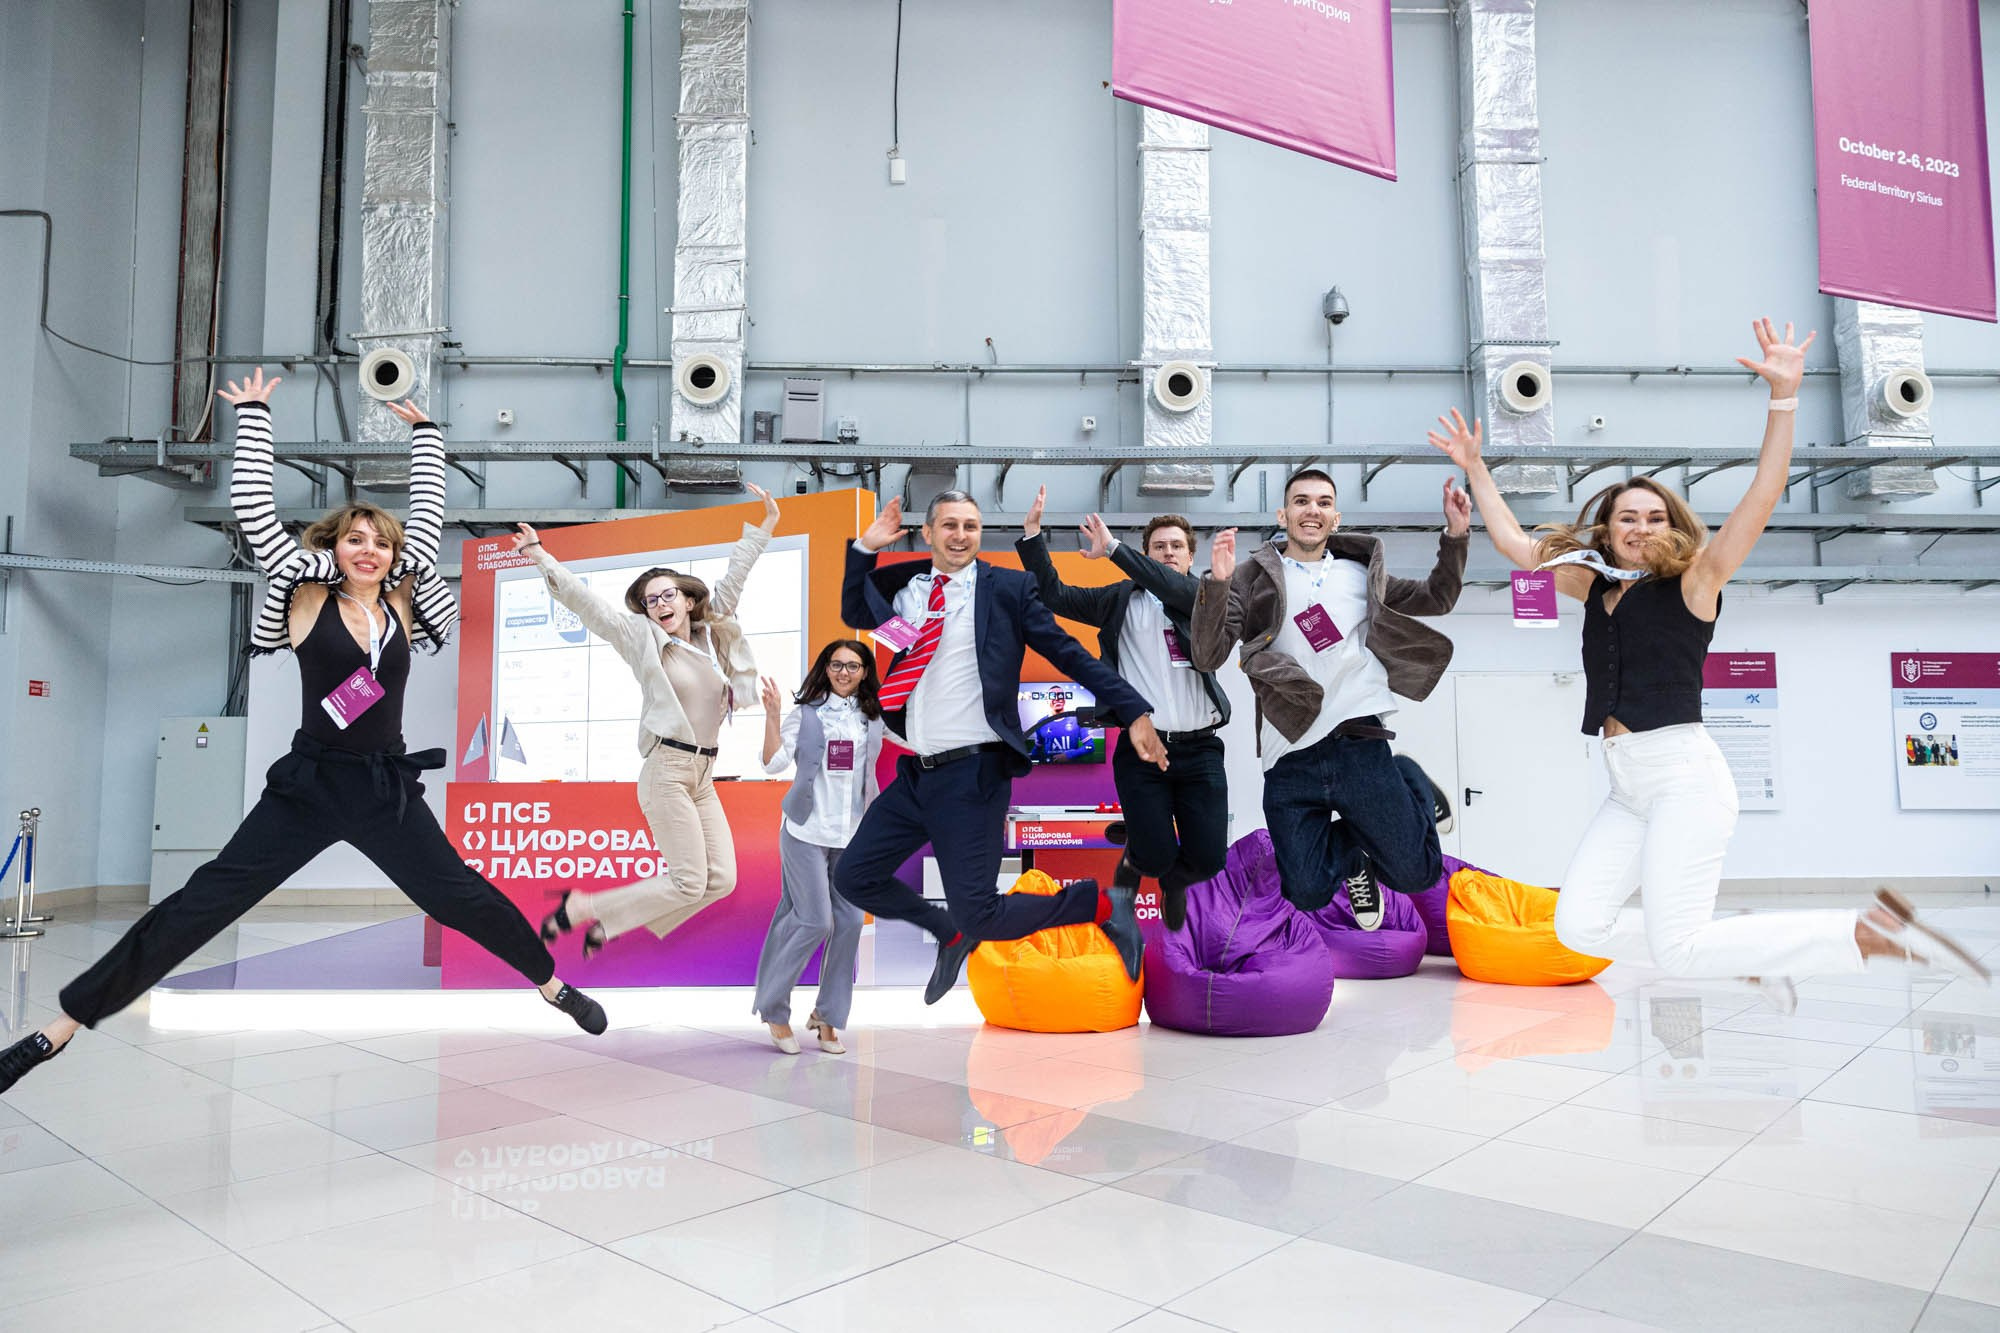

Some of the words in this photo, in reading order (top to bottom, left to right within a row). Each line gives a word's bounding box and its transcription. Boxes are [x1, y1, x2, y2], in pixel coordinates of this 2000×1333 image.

[1839, 136, 1896, 162] October
[1897, 150, 1925, 172] 2-6,
[1925, 157, 1960, 178] 2023
[1841, 174, 1877, 192] Federal
[1877, 182, 1916, 203] territory
[1916, 190, 1943, 207] Sirius
[484, 543, 499, 552] ПСБ
[484, 550, 523, 561] ЦИФРОВА
[491, 801, 551, 824] ПСБ
[491, 829, 659, 854] ЦИФРОВА
[1028, 838, 1083, 846] ЛАБОРАТОРИЯ
